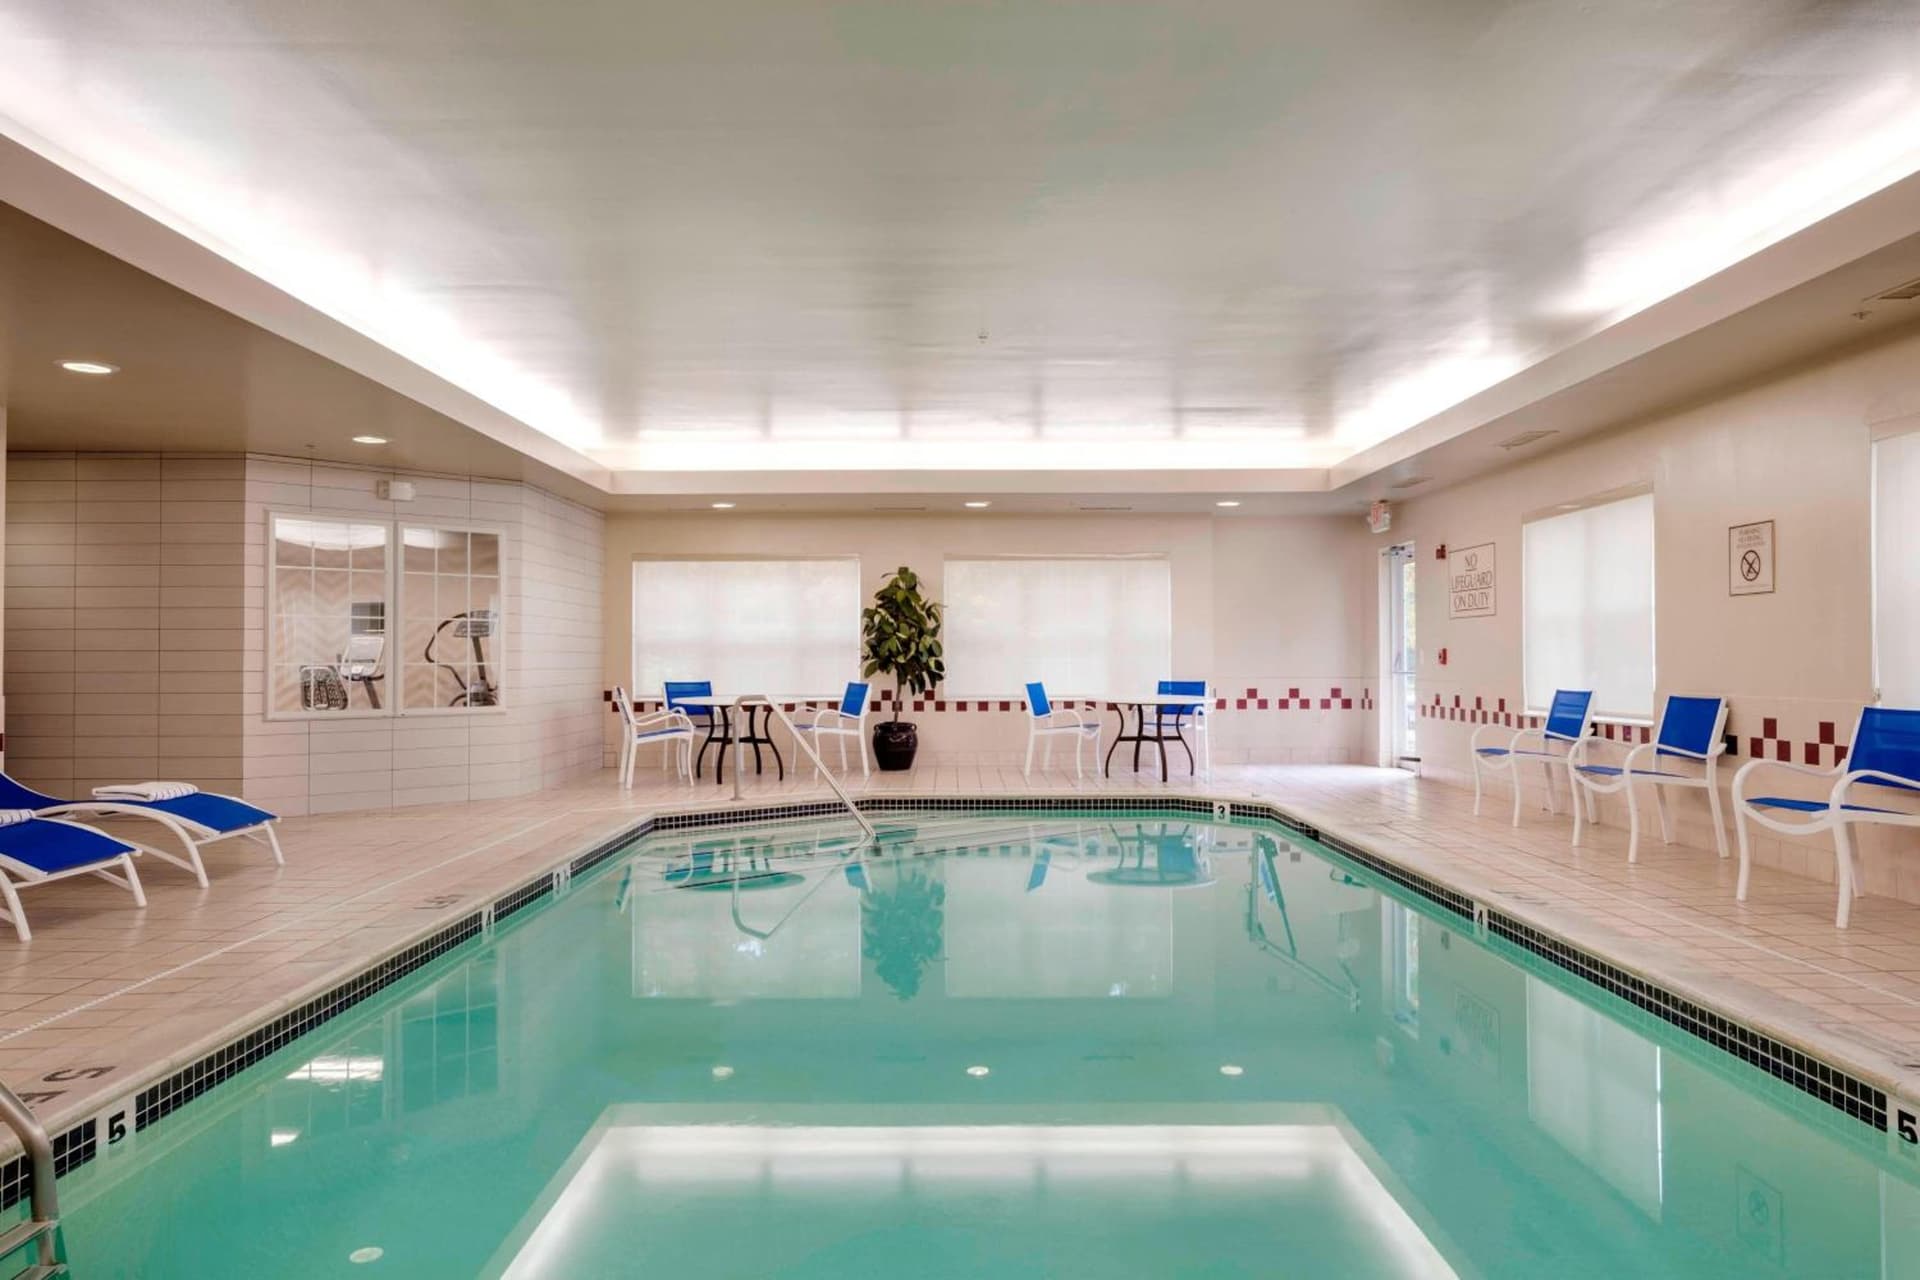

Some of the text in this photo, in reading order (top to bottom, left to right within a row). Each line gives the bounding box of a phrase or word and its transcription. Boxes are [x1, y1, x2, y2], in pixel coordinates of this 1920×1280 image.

[1464, 552, 1478, 569] NO
[1451, 570, 1493, 590] LIFEGUARD
[1453, 592, 1489, 609] ON DUTY
[108, 1110, 126, 1145] 5
[1897, 1108, 1919, 1145] 5
